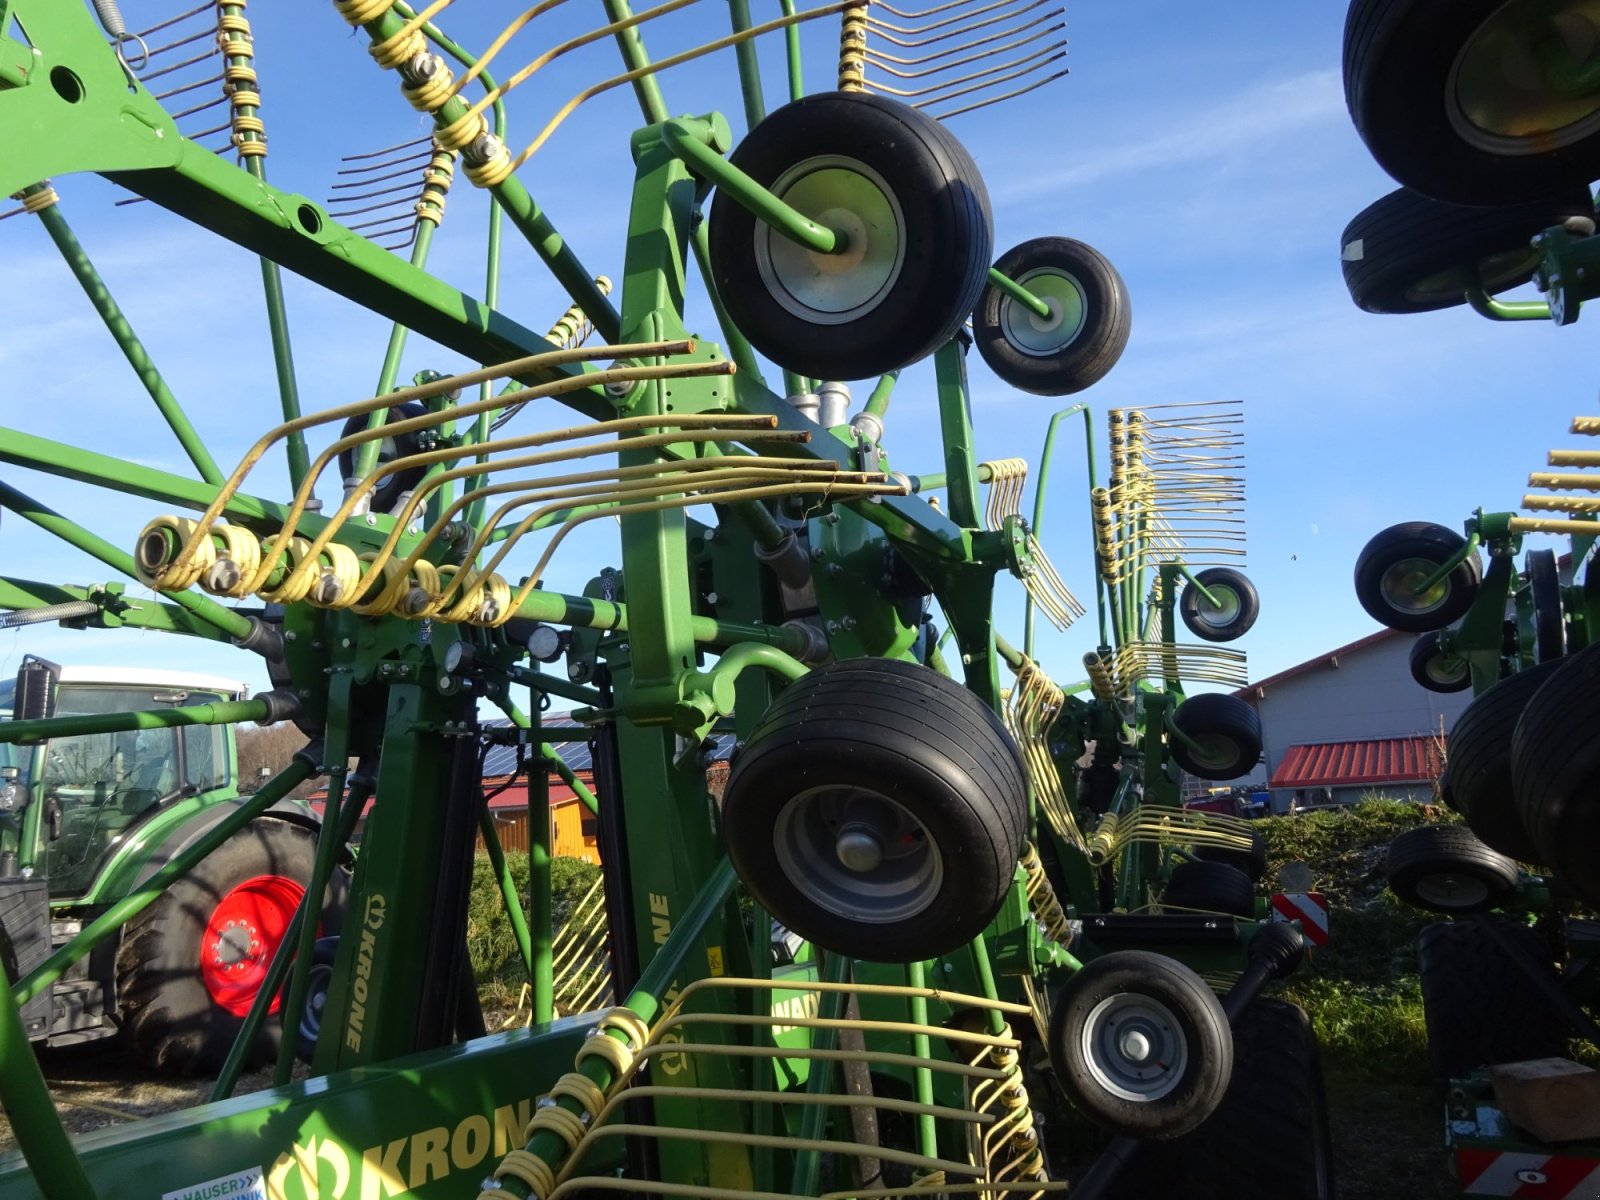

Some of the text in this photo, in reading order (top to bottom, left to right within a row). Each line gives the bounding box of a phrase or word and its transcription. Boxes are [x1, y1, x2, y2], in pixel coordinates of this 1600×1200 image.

[346, 929, 376, 1054] KRONE
[771, 991, 821, 1035] WAD
[361, 1096, 545, 1200] KRON
[183, 1179, 238, 1200] HAUSER
